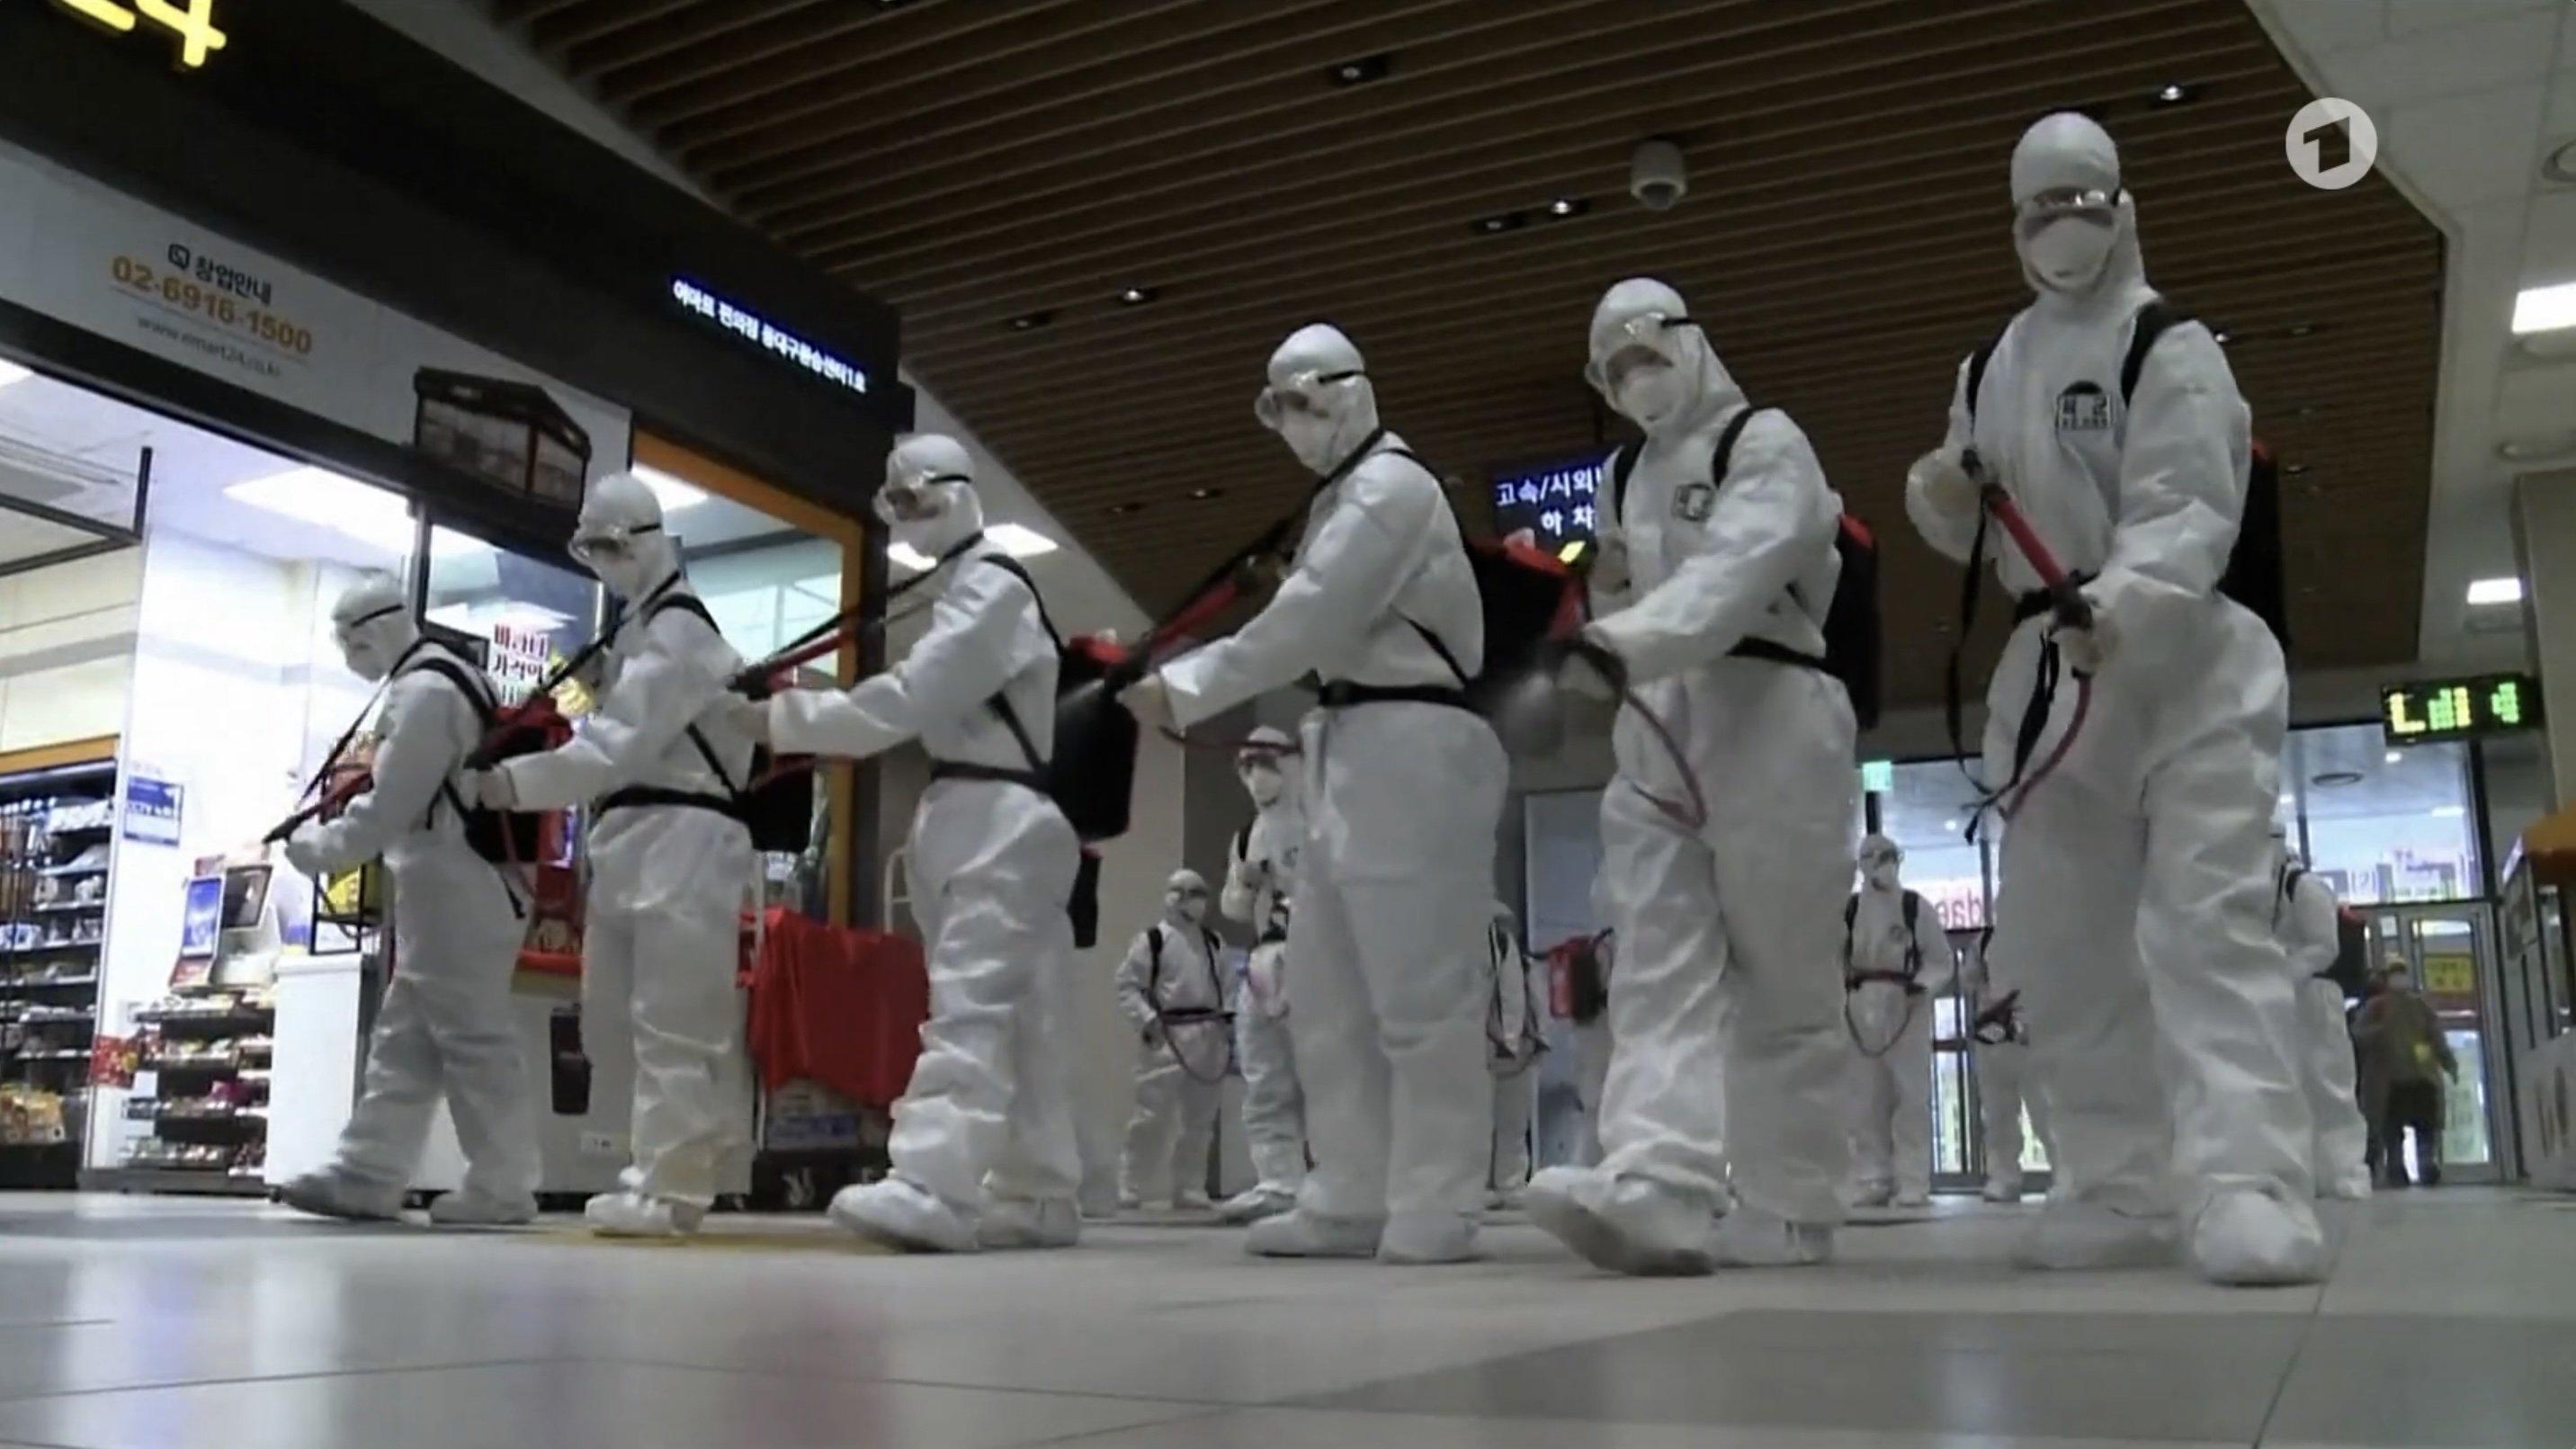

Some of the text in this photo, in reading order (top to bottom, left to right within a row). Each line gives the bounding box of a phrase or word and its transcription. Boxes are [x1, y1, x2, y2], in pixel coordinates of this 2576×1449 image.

[112, 255, 313, 354] 02-6916-1500
[195, 255, 273, 305] 창업안내
[1496, 465, 1602, 507] 고속/시외
